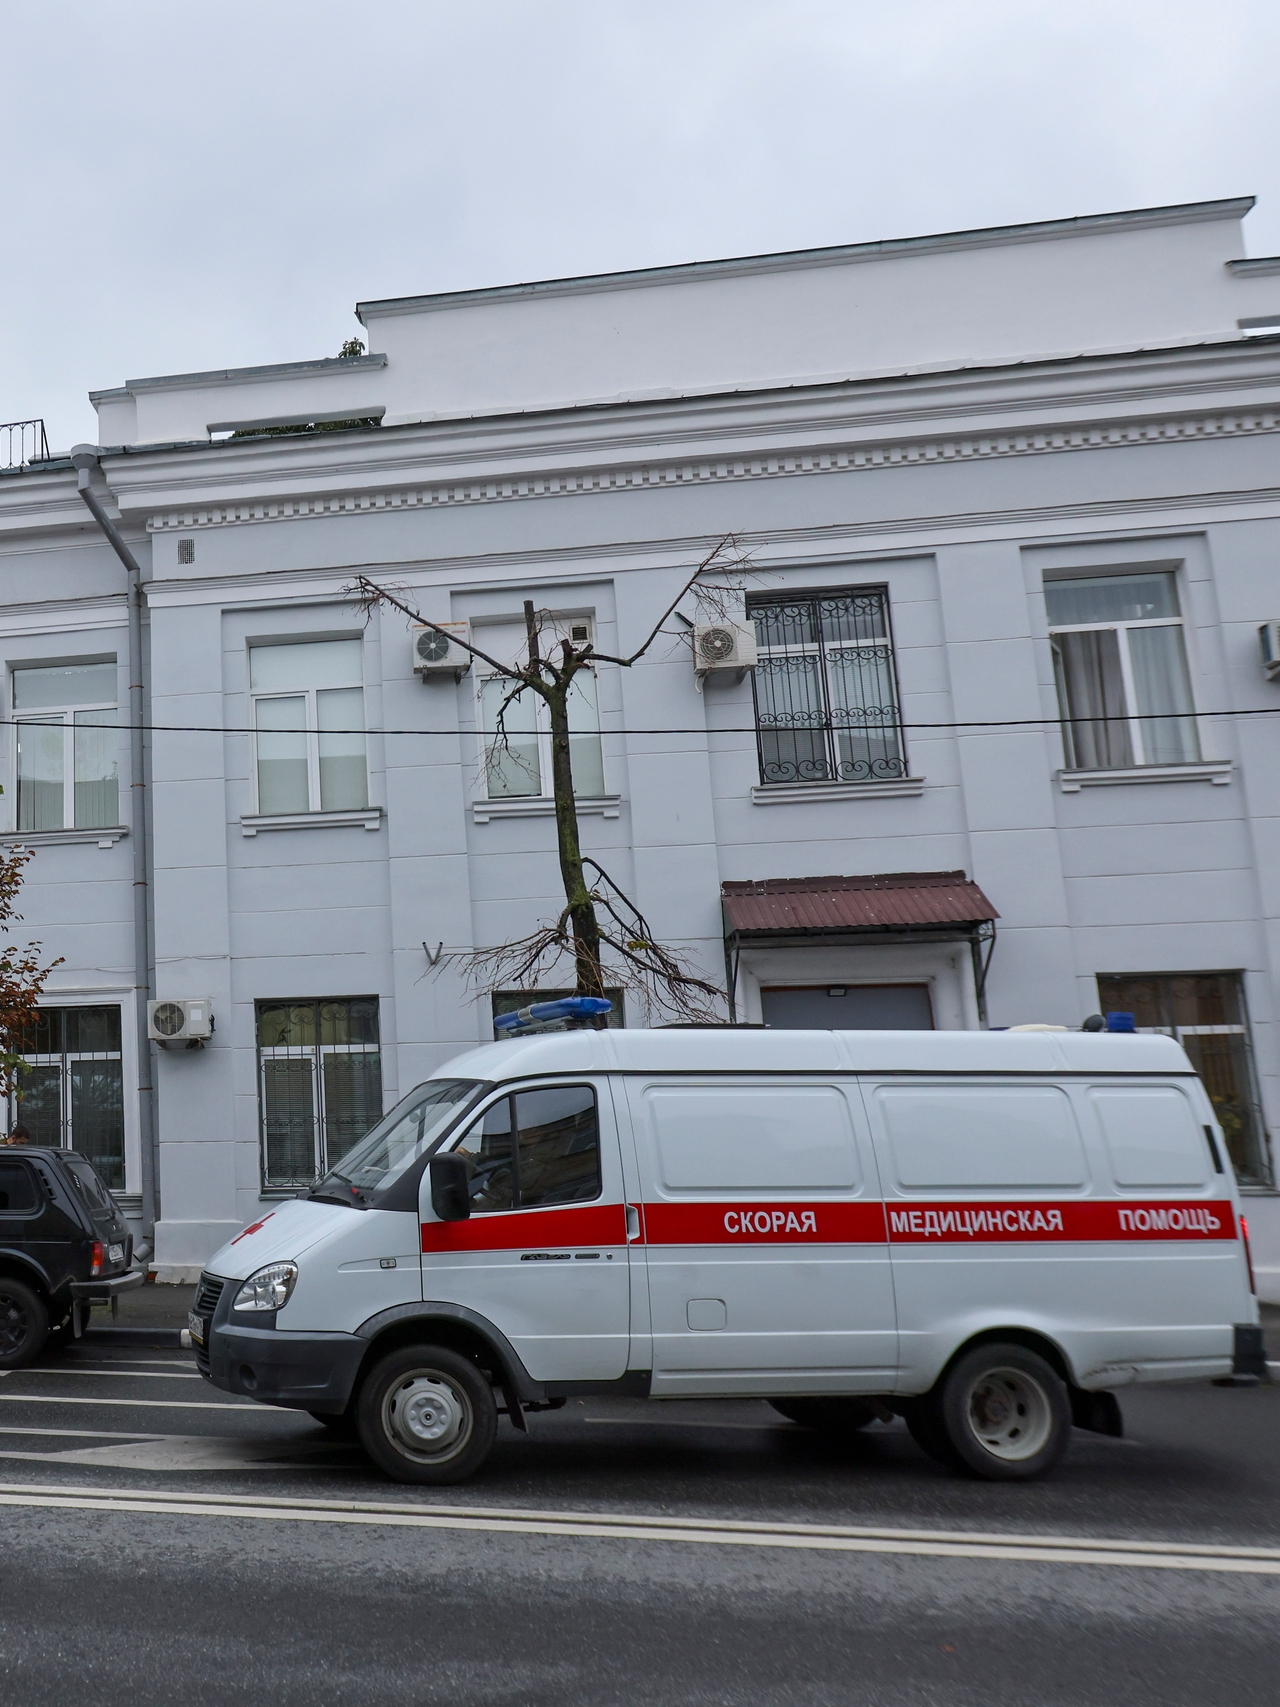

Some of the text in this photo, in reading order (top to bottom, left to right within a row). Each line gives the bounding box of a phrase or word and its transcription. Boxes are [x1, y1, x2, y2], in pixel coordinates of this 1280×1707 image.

[724, 1208, 1221, 1236] СКОРАЯ МЕДИЦИНСКАЯ ПОМОЩЬ
